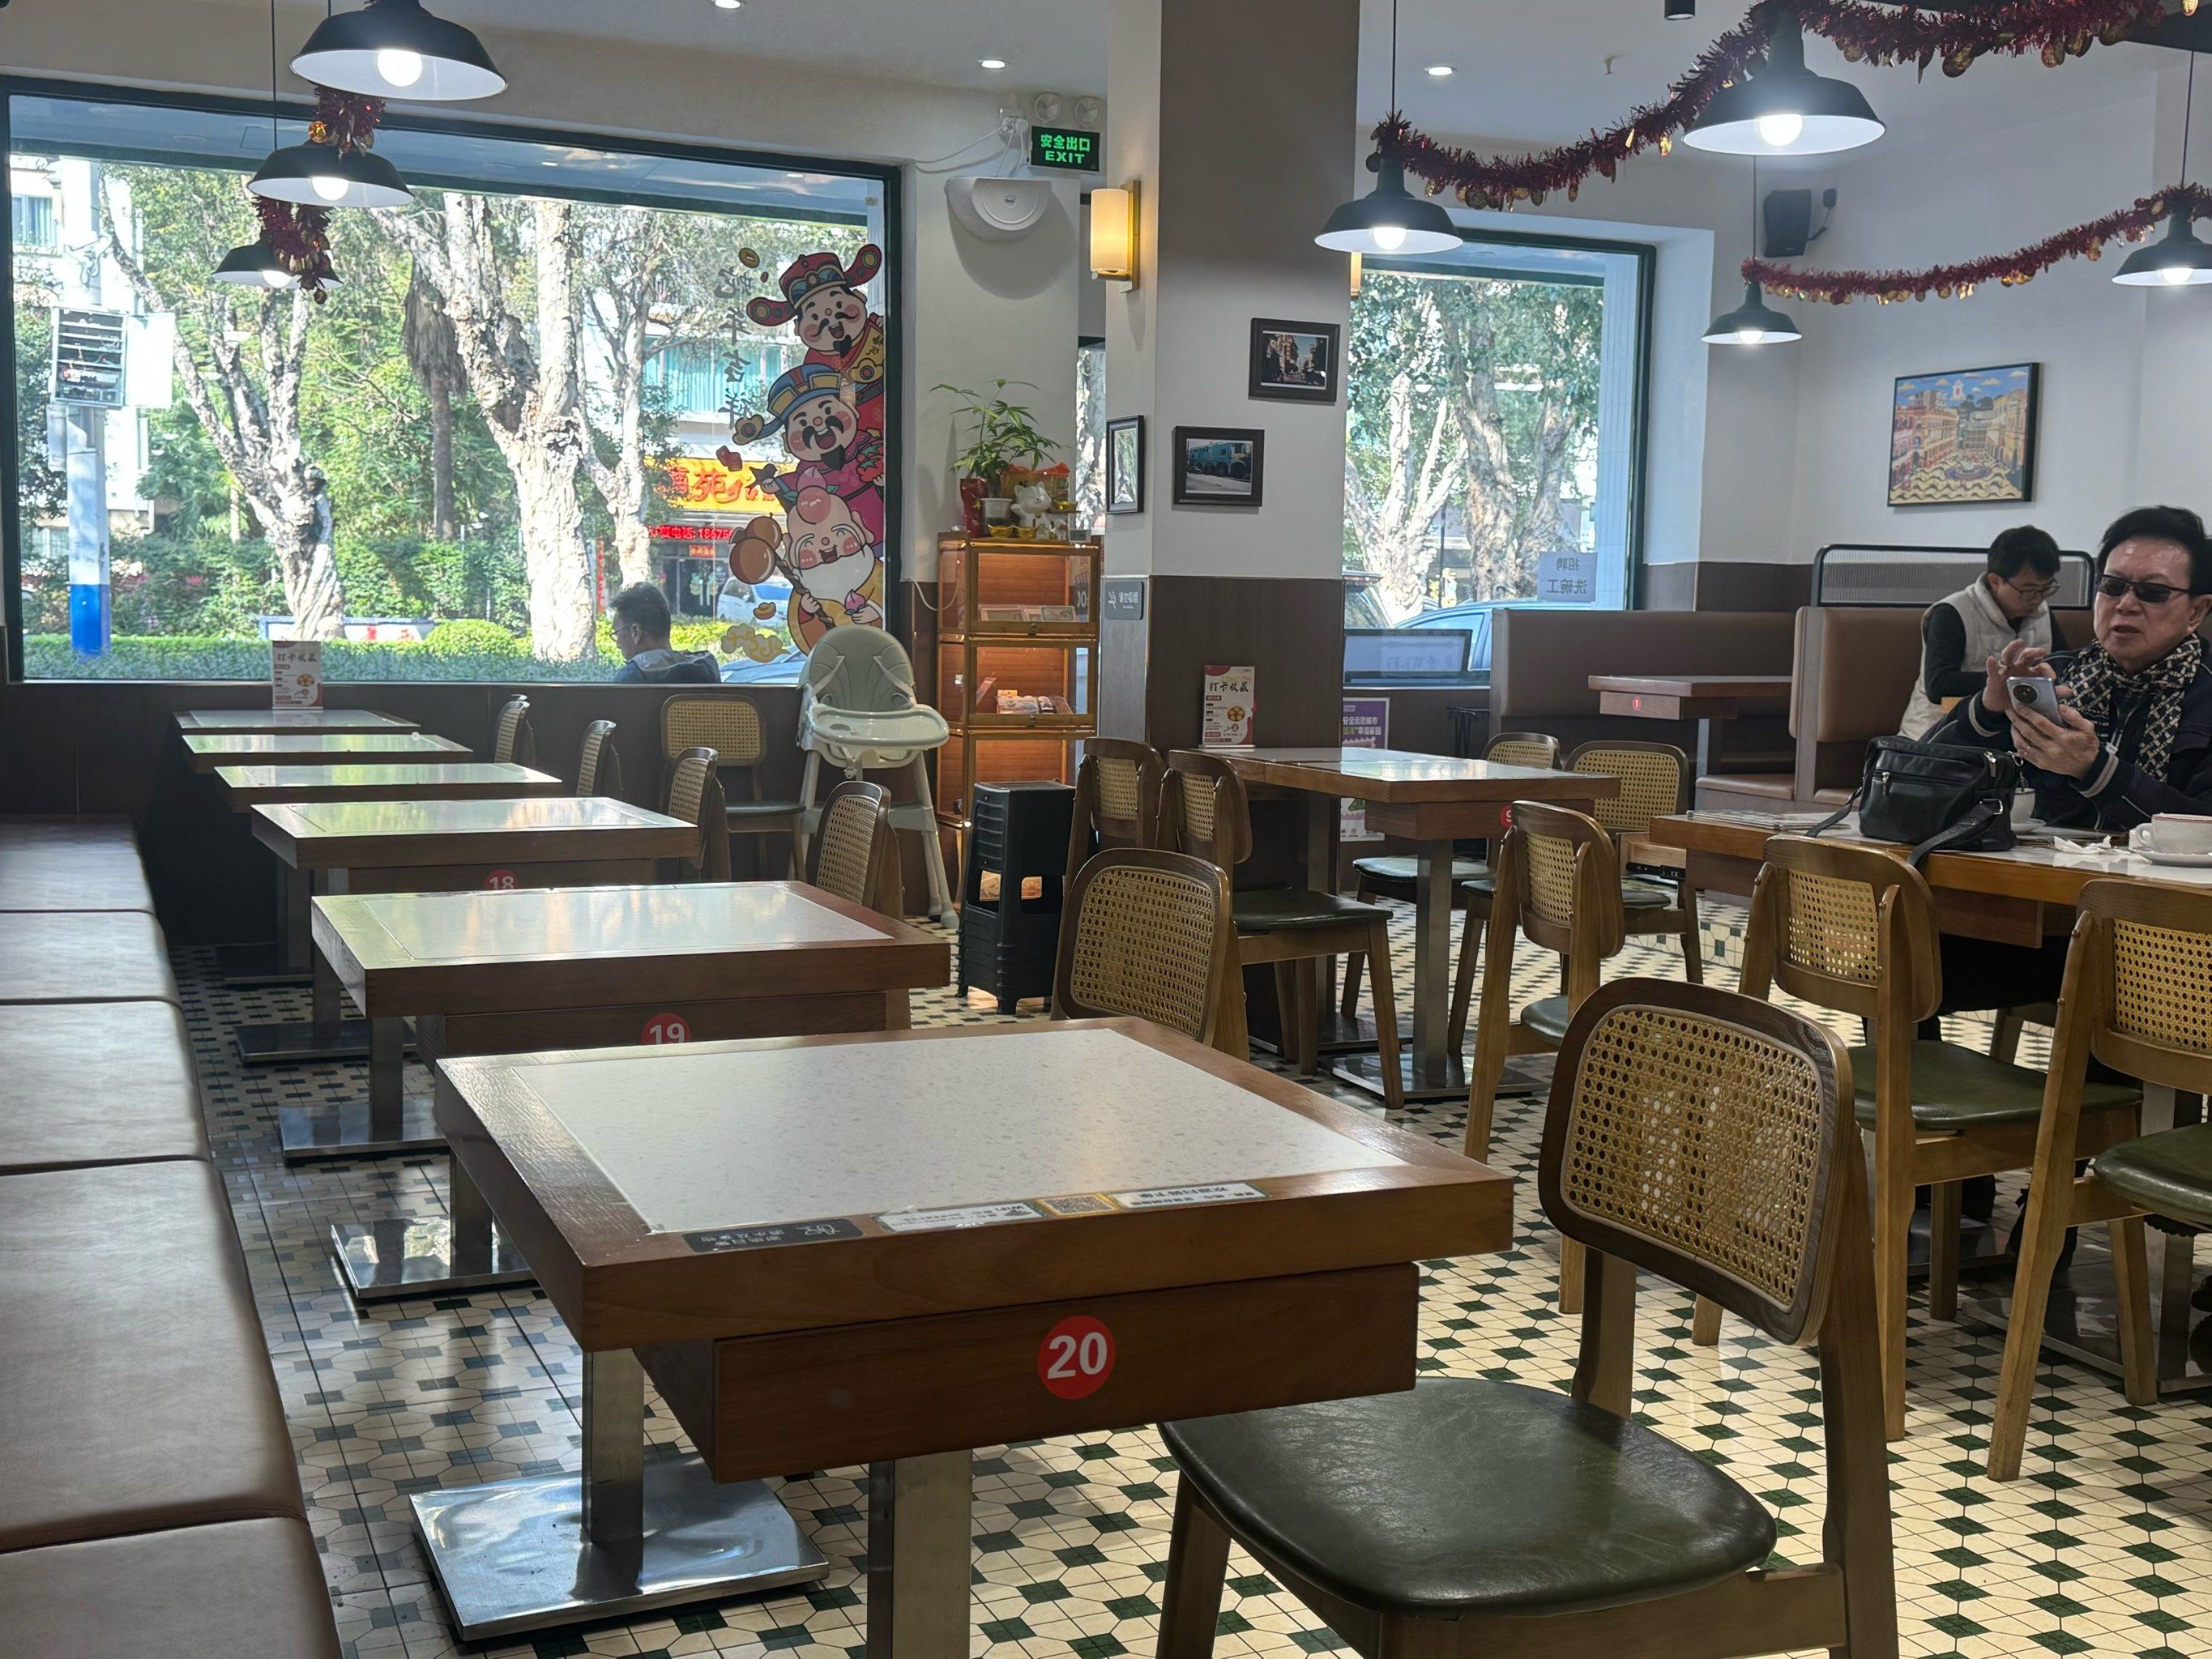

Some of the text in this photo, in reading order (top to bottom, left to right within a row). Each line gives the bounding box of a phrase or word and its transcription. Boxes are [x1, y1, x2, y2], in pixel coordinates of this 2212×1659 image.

[1040, 134, 1091, 152] 安全出口
[1045, 151, 1086, 164] EXIT
[1208, 681, 1249, 693] 打卡收藏
[489, 876, 515, 890] 18
[650, 1023, 685, 1045] 19
[1048, 1332, 1108, 1380] 20
